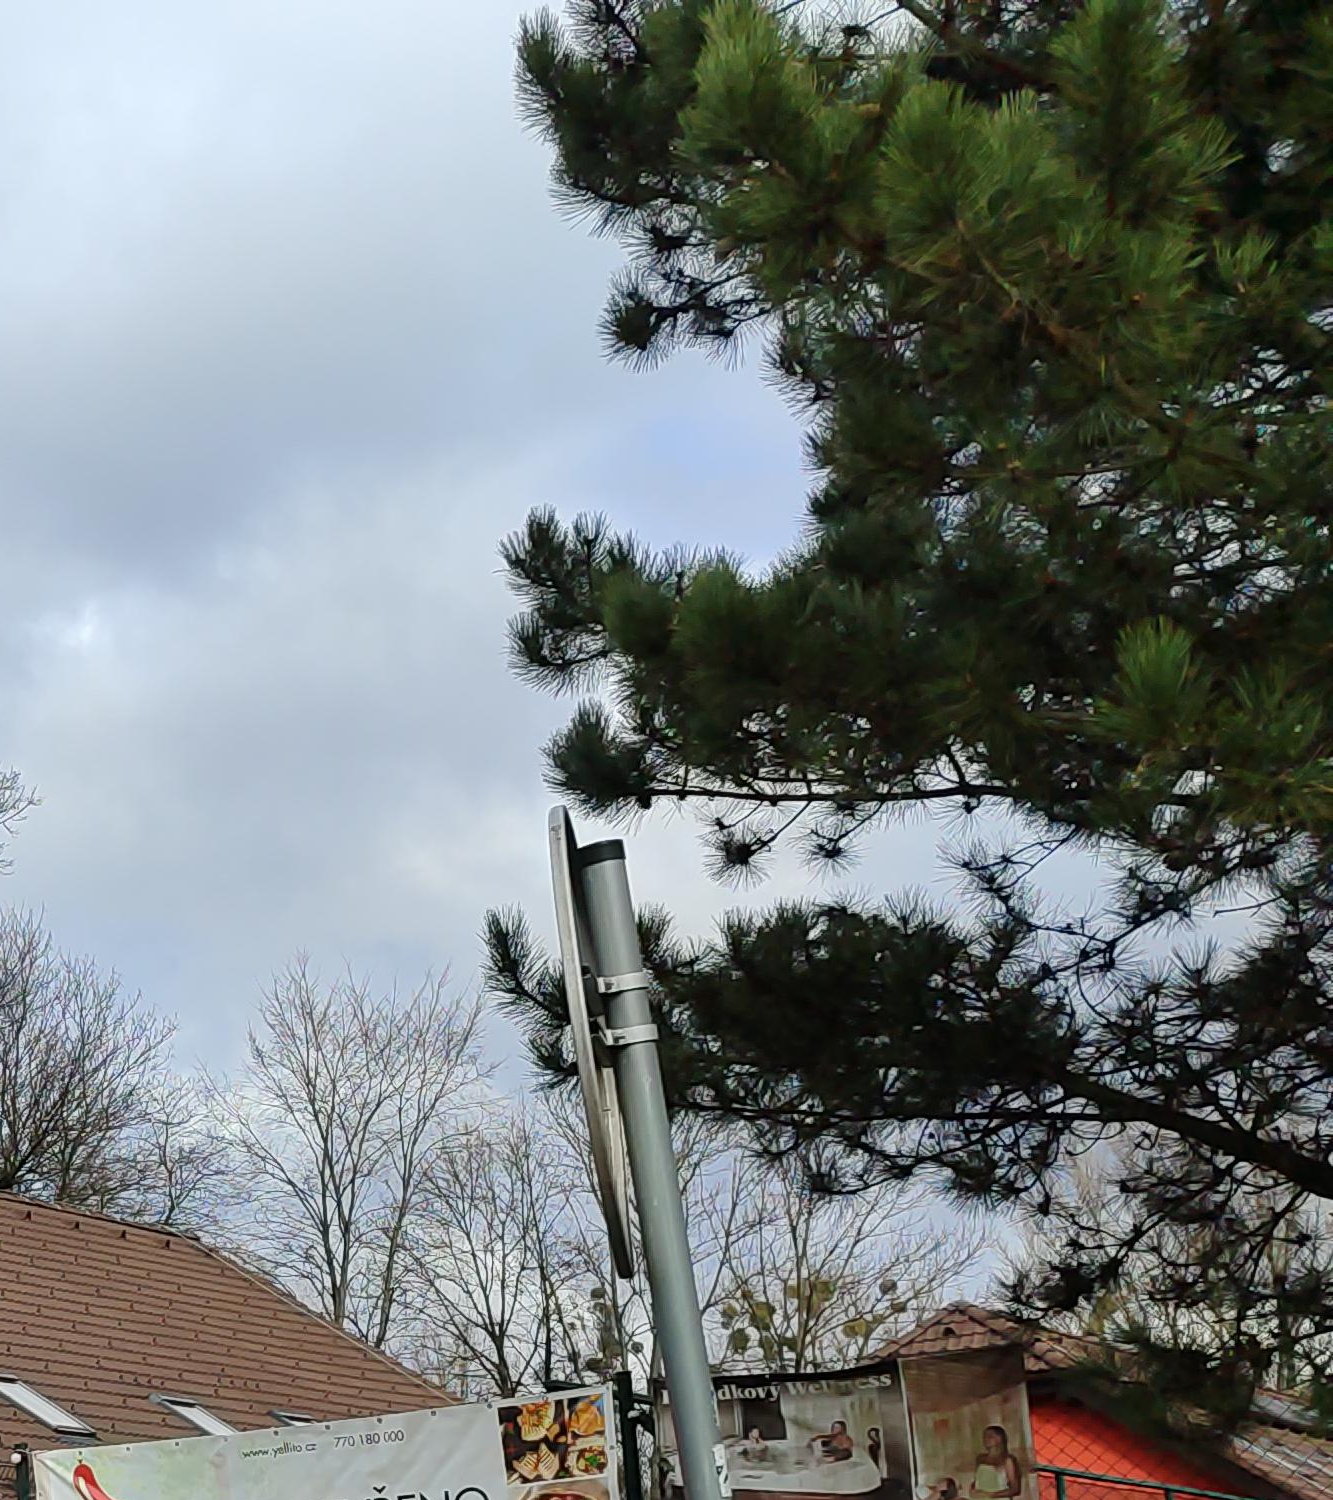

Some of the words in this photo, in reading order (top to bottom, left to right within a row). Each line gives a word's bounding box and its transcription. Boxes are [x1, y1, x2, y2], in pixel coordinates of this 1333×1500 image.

[786, 1373, 892, 1397] Weless
[334, 1435, 355, 1449] 770
[359, 1432, 380, 1446] 180
[384, 1430, 405, 1443] 000
